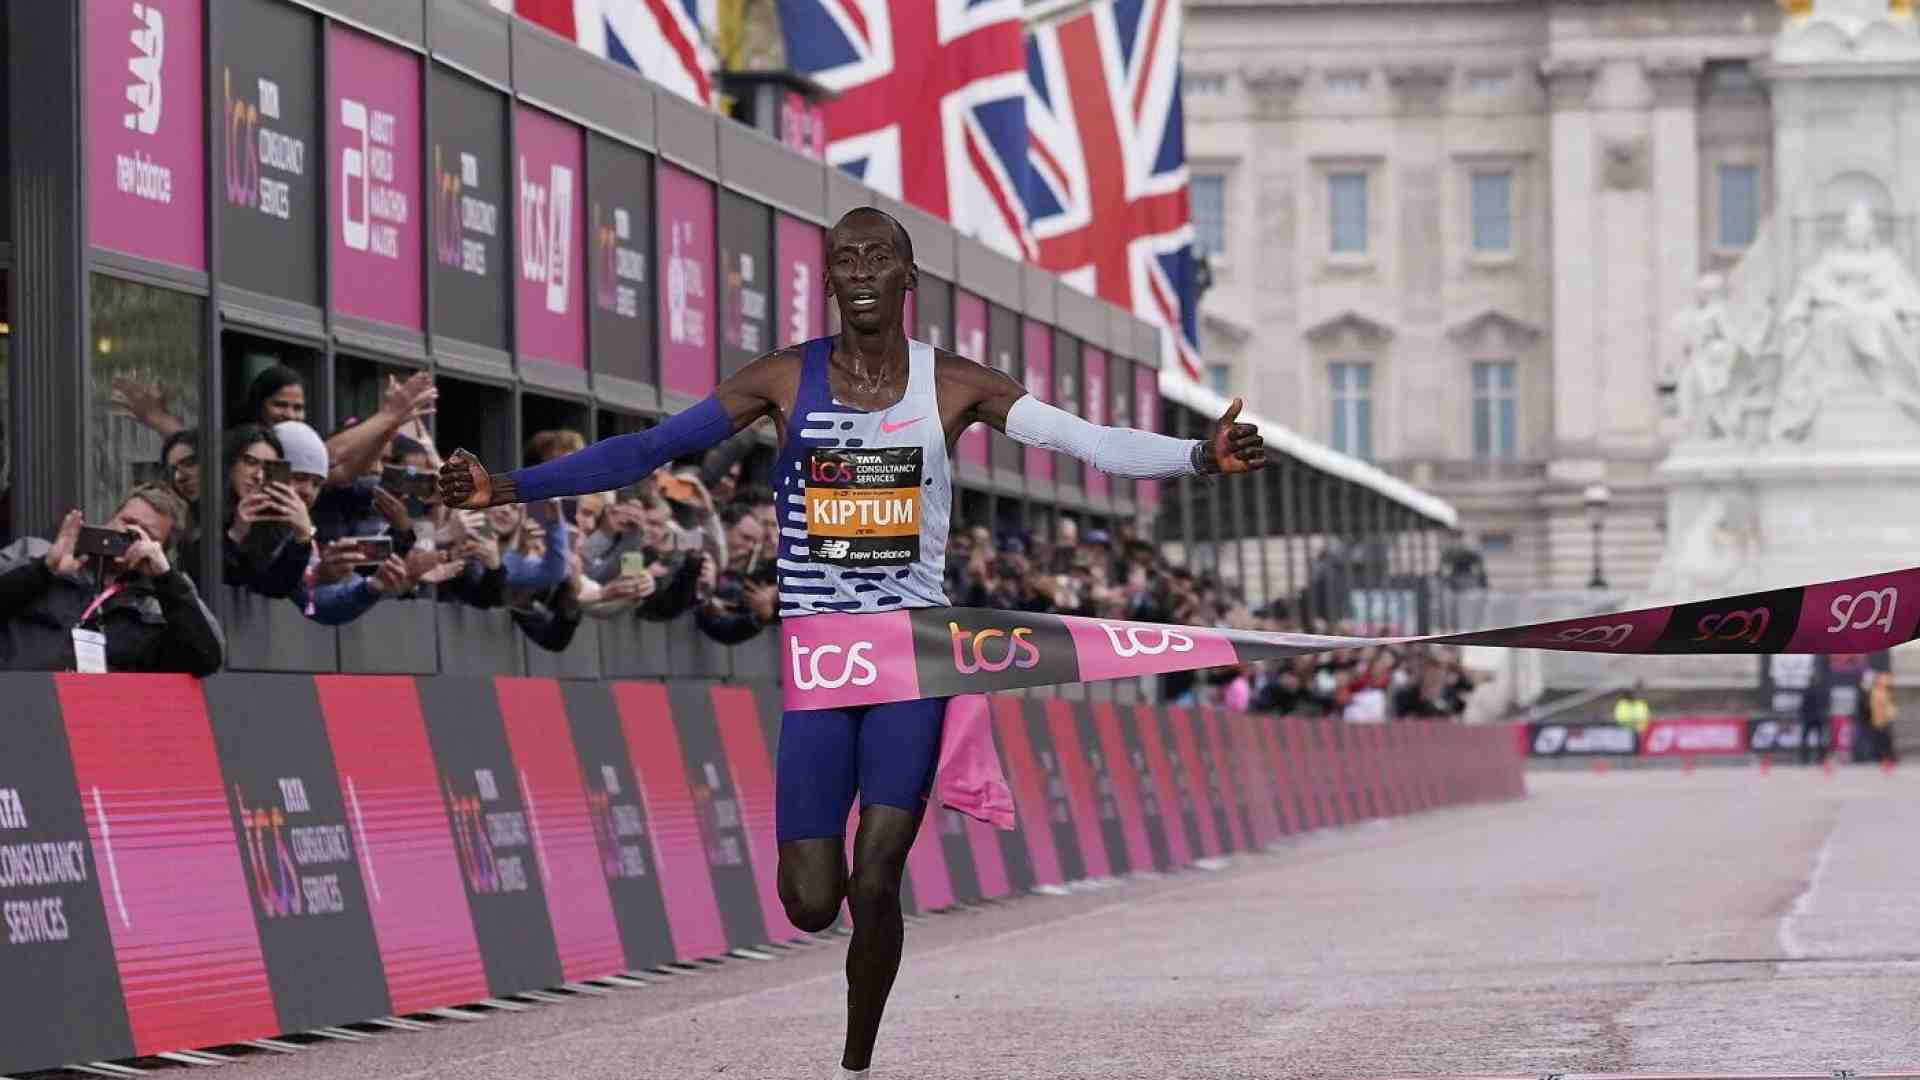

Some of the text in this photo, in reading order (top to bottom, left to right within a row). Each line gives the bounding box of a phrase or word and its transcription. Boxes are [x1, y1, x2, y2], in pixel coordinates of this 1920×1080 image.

[223, 65, 258, 207] tcs
[116, 153, 136, 193] new
[519, 154, 548, 283] tcs
[810, 455, 854, 482] tcs
[856, 456, 882, 464] TATA
[856, 464, 916, 474] CONSULTANCY
[856, 474, 896, 484] SERVICES
[813, 498, 913, 525] KIPTUM
[849, 551, 871, 560] new
[872, 549, 912, 559] balance
[1828, 587, 1898, 634] tcs
[949, 621, 1041, 674] tcs
[1099, 623, 1194, 657] tcs
[788, 635, 878, 690] tcs
[233, 782, 303, 919] tcs
[4, 896, 70, 944] SERVICES
